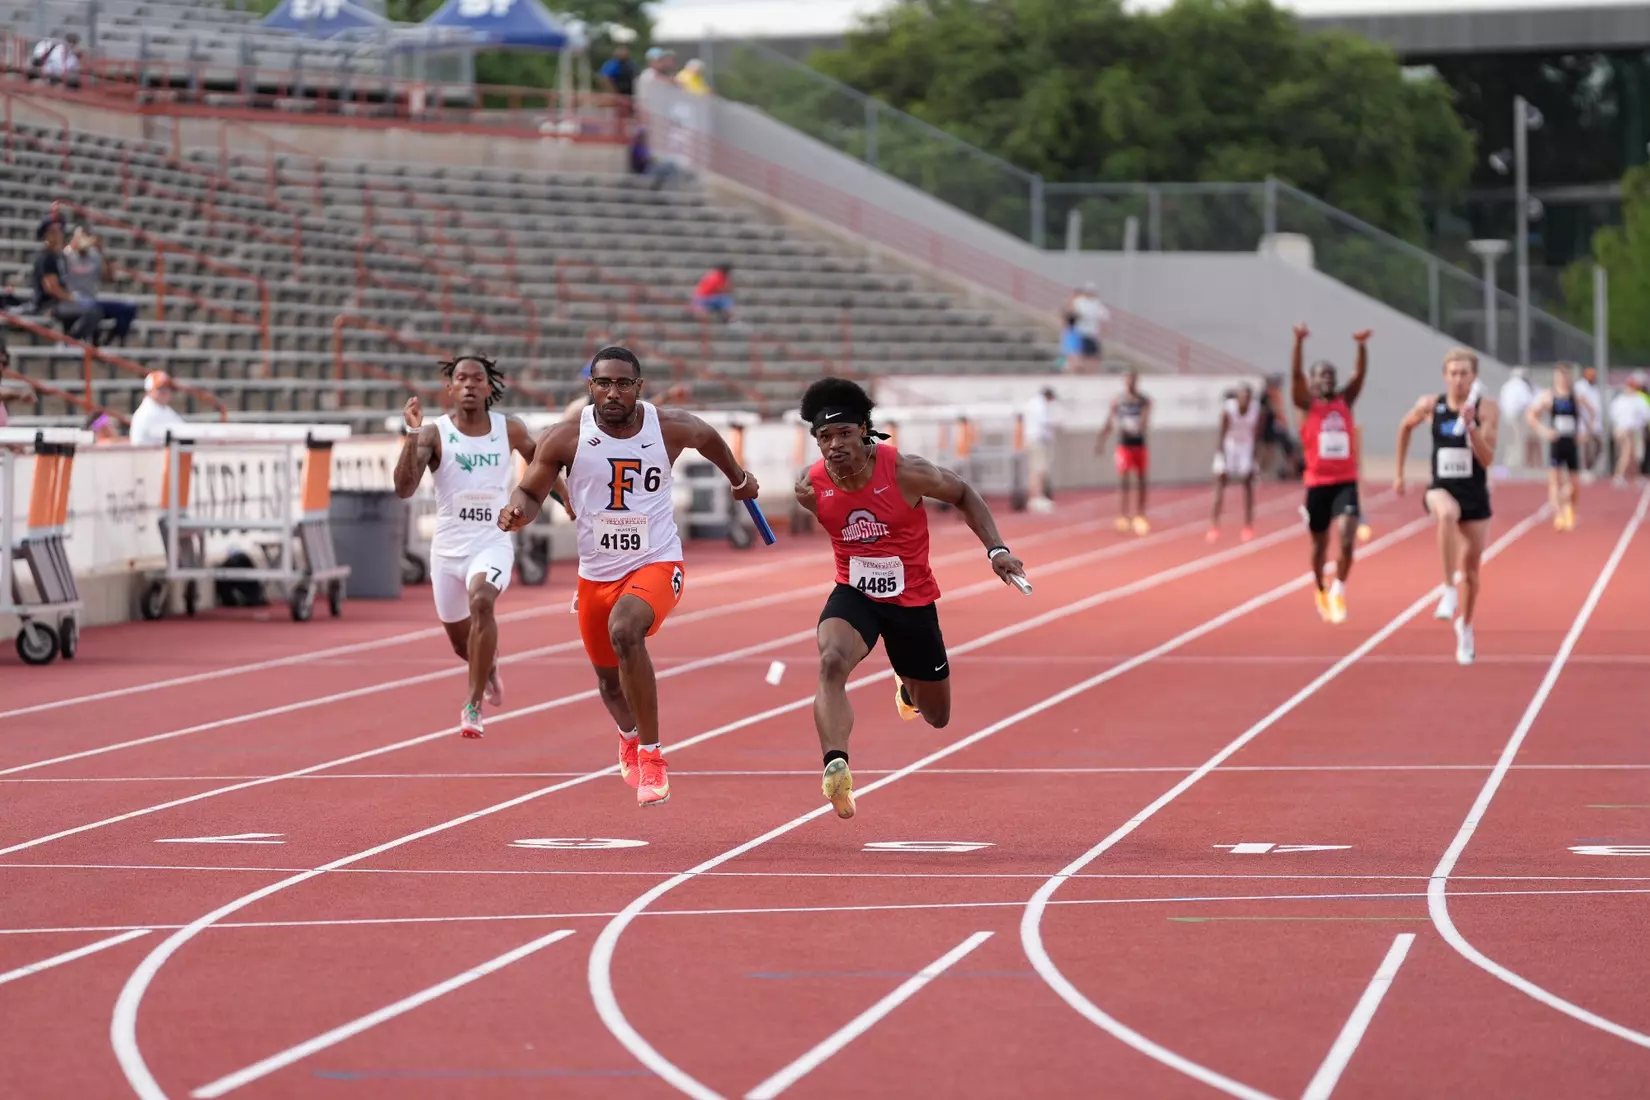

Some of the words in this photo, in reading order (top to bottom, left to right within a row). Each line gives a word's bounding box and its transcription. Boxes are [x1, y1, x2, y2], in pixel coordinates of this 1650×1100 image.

[468, 453, 501, 467] UNT
[604, 457, 643, 511] F
[643, 466, 661, 493] 6
[459, 507, 492, 522] 4456
[600, 533, 641, 550] 4159
[490, 566, 502, 583] 7
[856, 576, 897, 593] 4485
